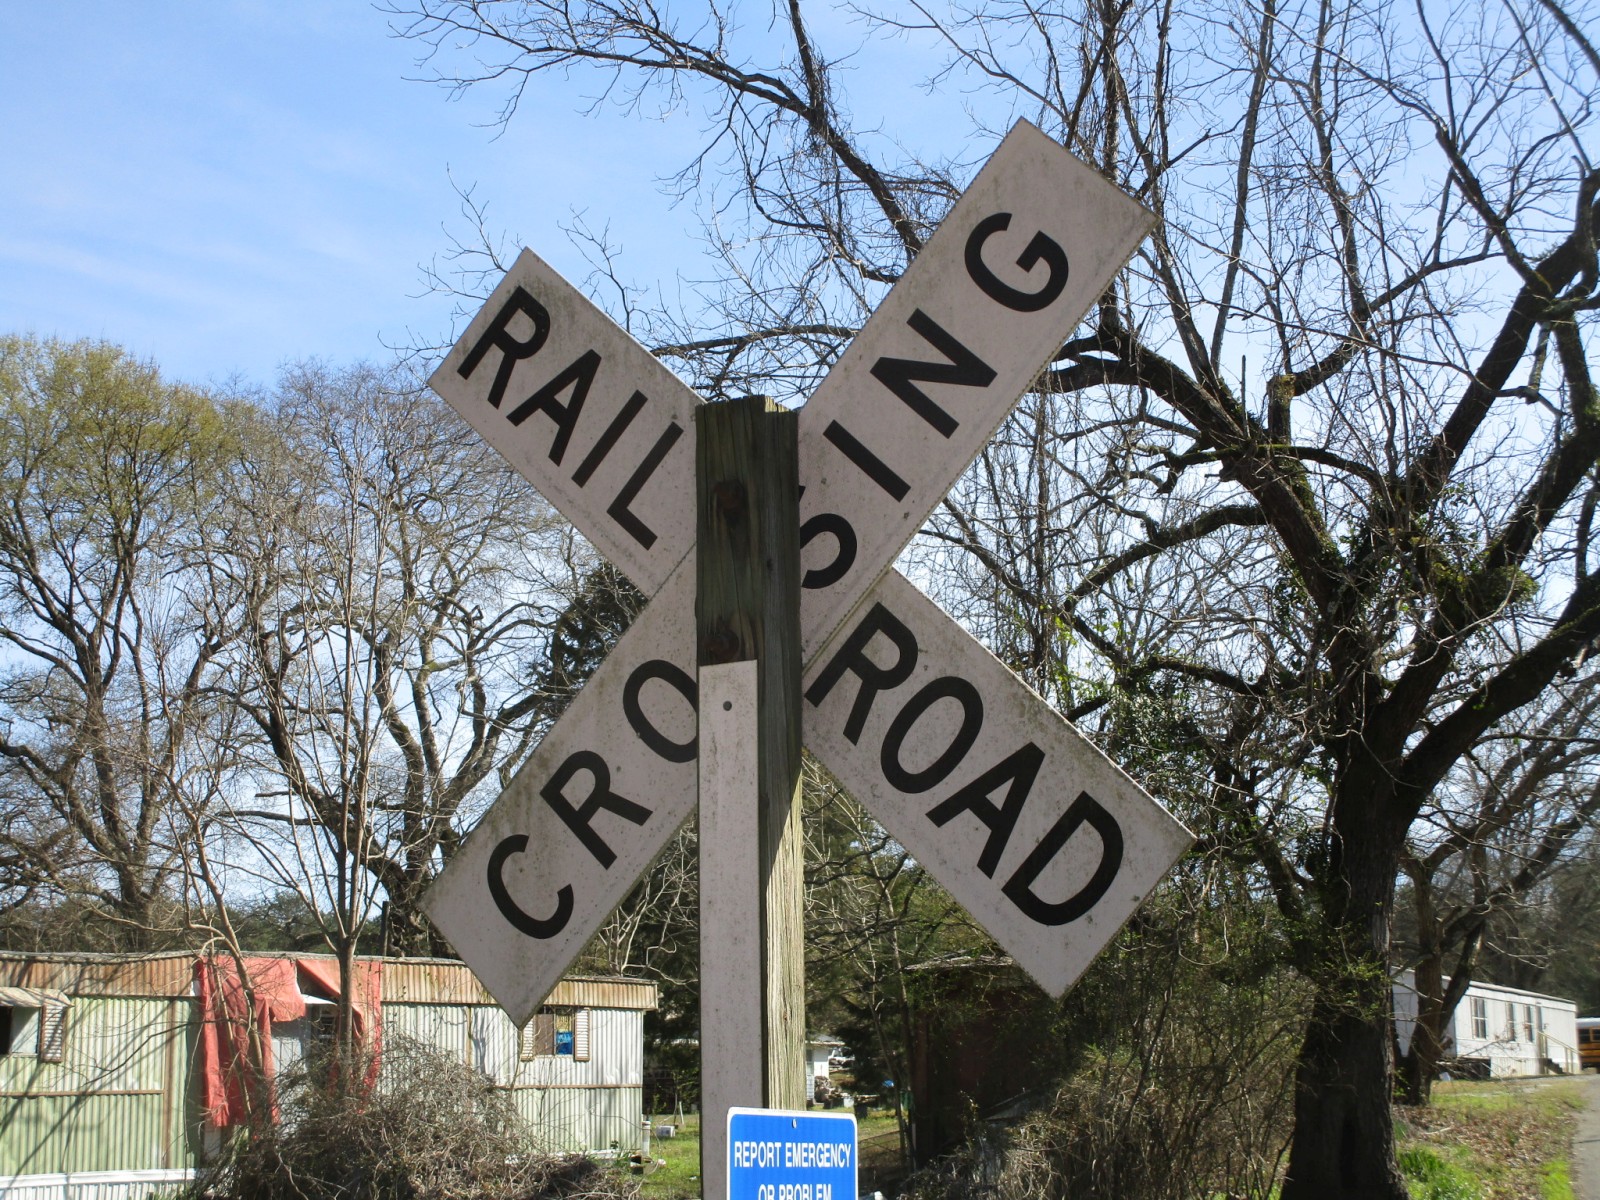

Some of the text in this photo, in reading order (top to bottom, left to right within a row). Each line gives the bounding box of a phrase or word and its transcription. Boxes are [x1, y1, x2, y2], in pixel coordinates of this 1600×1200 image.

[456, 284, 1125, 926] RAIL ROAD
[734, 1141, 851, 1168] REPORT EMERGENCY
[758, 1184, 832, 1200] OR PROBLEM
